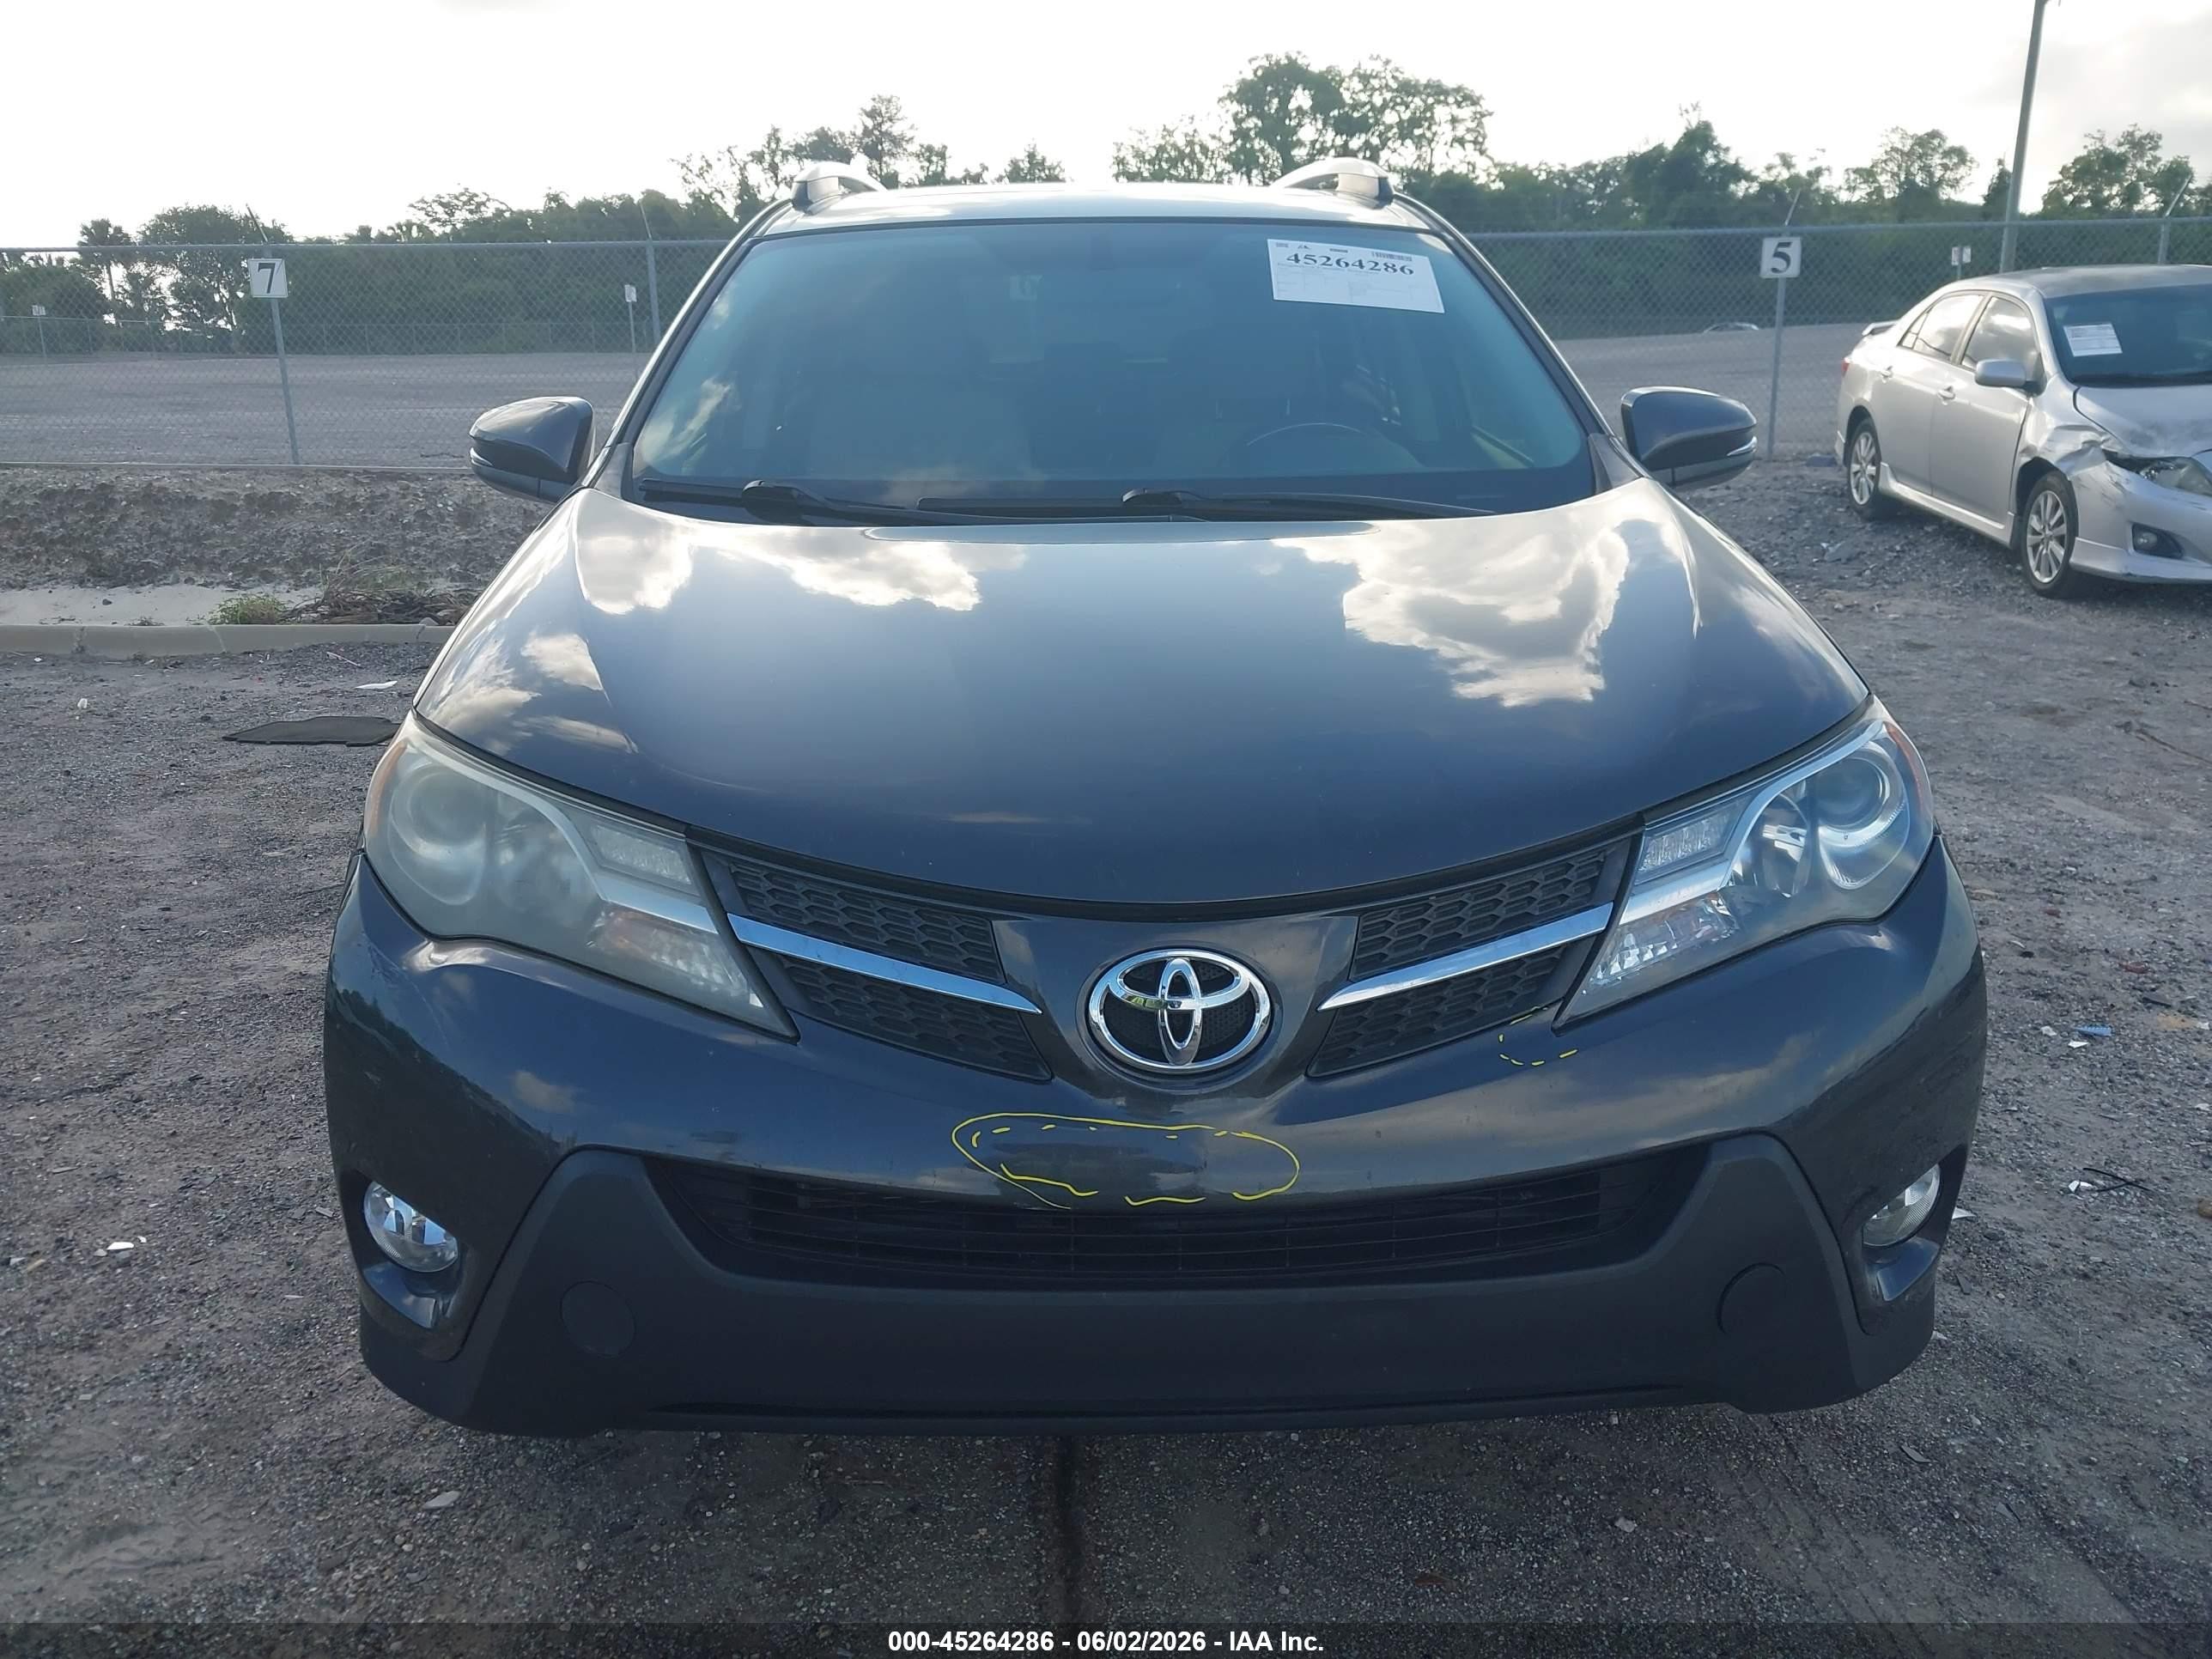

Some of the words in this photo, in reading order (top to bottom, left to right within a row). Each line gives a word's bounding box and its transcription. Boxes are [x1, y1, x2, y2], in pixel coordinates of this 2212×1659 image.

[1286, 252, 1414, 275] 45264286
[1771, 241, 1793, 274] 5
[258, 263, 276, 294] 7
